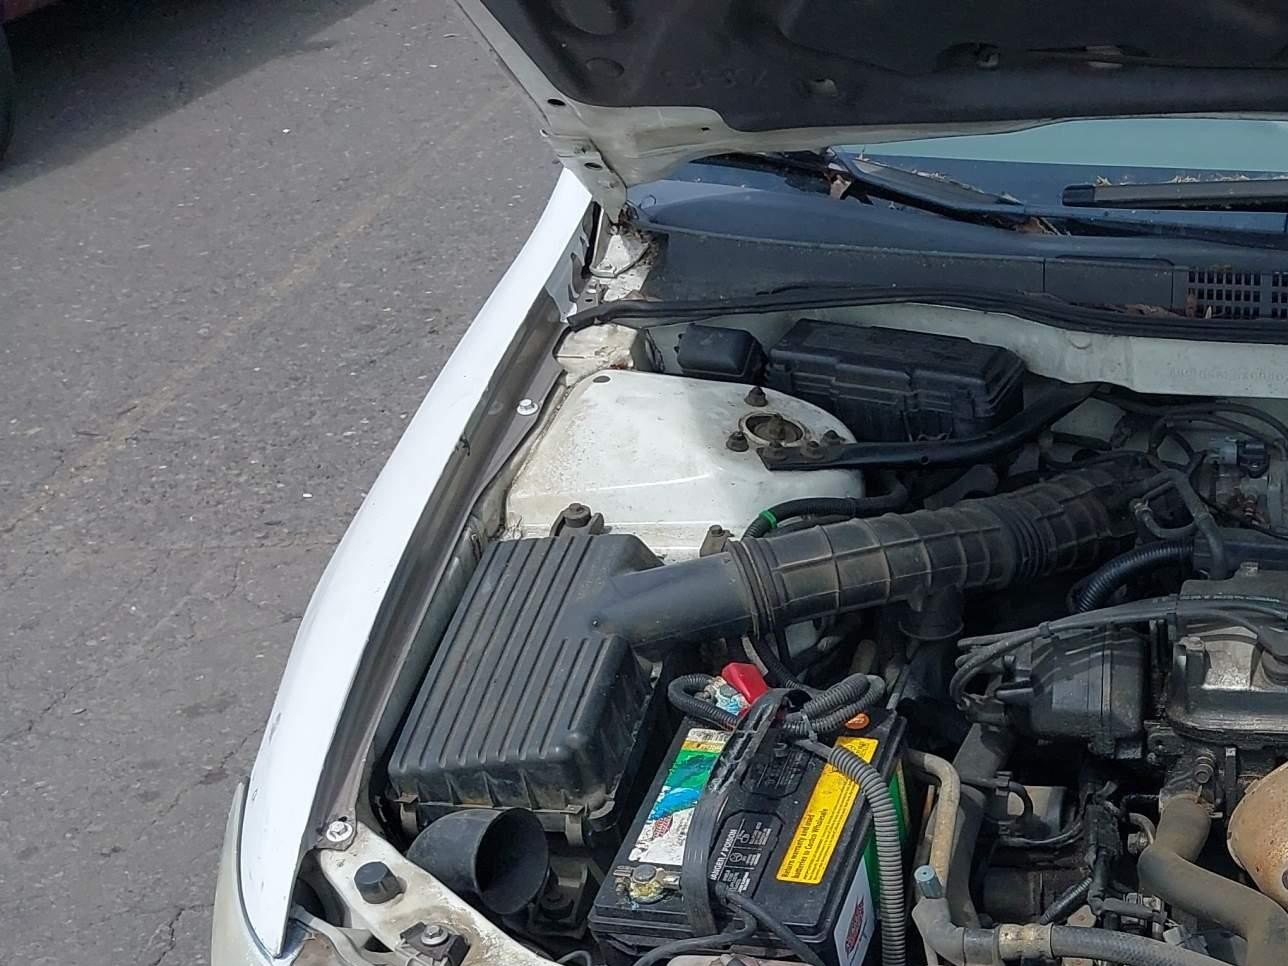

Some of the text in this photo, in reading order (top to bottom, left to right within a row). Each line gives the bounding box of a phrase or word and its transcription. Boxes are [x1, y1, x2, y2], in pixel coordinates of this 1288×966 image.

[710, 857, 725, 881] ANGER
[722, 829, 738, 852] POISON
[790, 837, 805, 860] warranty
[802, 826, 810, 837] and
[806, 814, 815, 827] used
[791, 852, 807, 879] batteries
[806, 833, 817, 849] Costco
[814, 808, 828, 833] Wholesale
